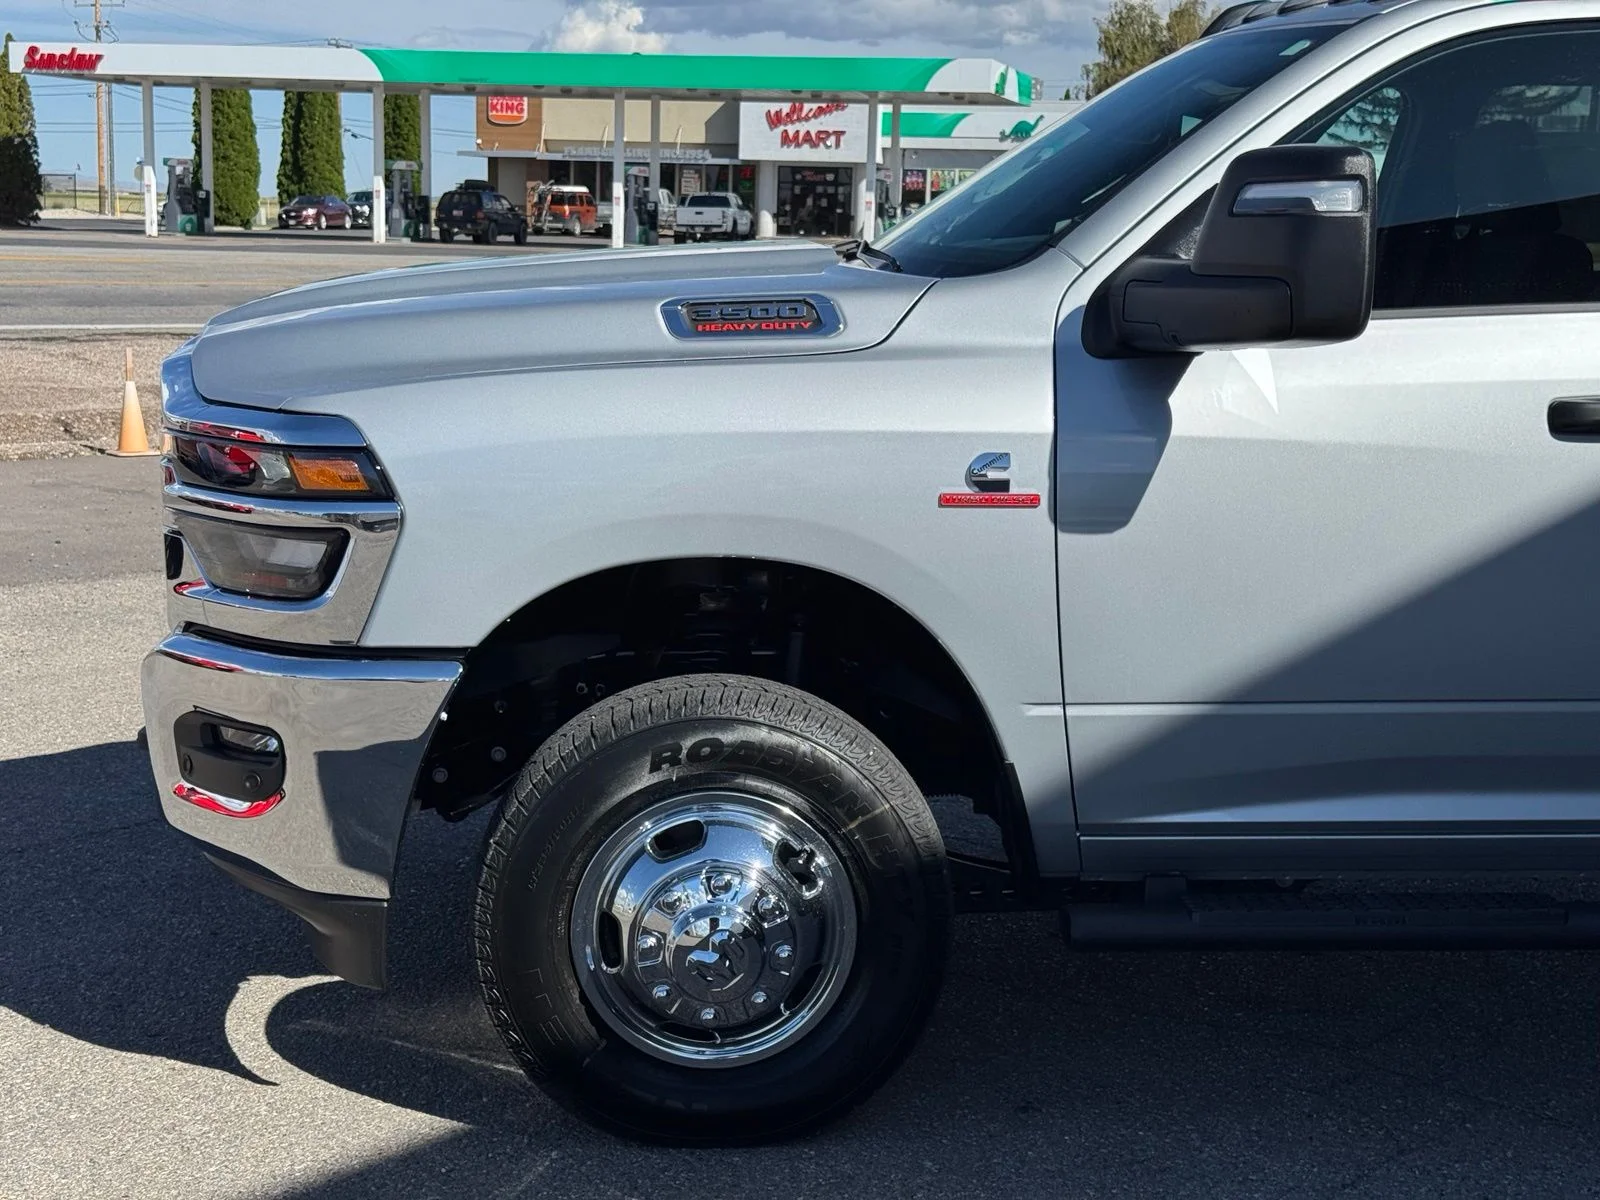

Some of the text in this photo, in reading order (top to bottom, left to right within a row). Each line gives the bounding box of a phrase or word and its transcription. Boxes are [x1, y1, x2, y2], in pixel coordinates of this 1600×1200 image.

[24, 45, 104, 70] Sinclair
[490, 101, 524, 114] KING
[780, 129, 846, 149] MART
[691, 303, 806, 320] 3500
[697, 321, 813, 332] HEAVY DUTY
[971, 453, 1009, 475] Cummins
